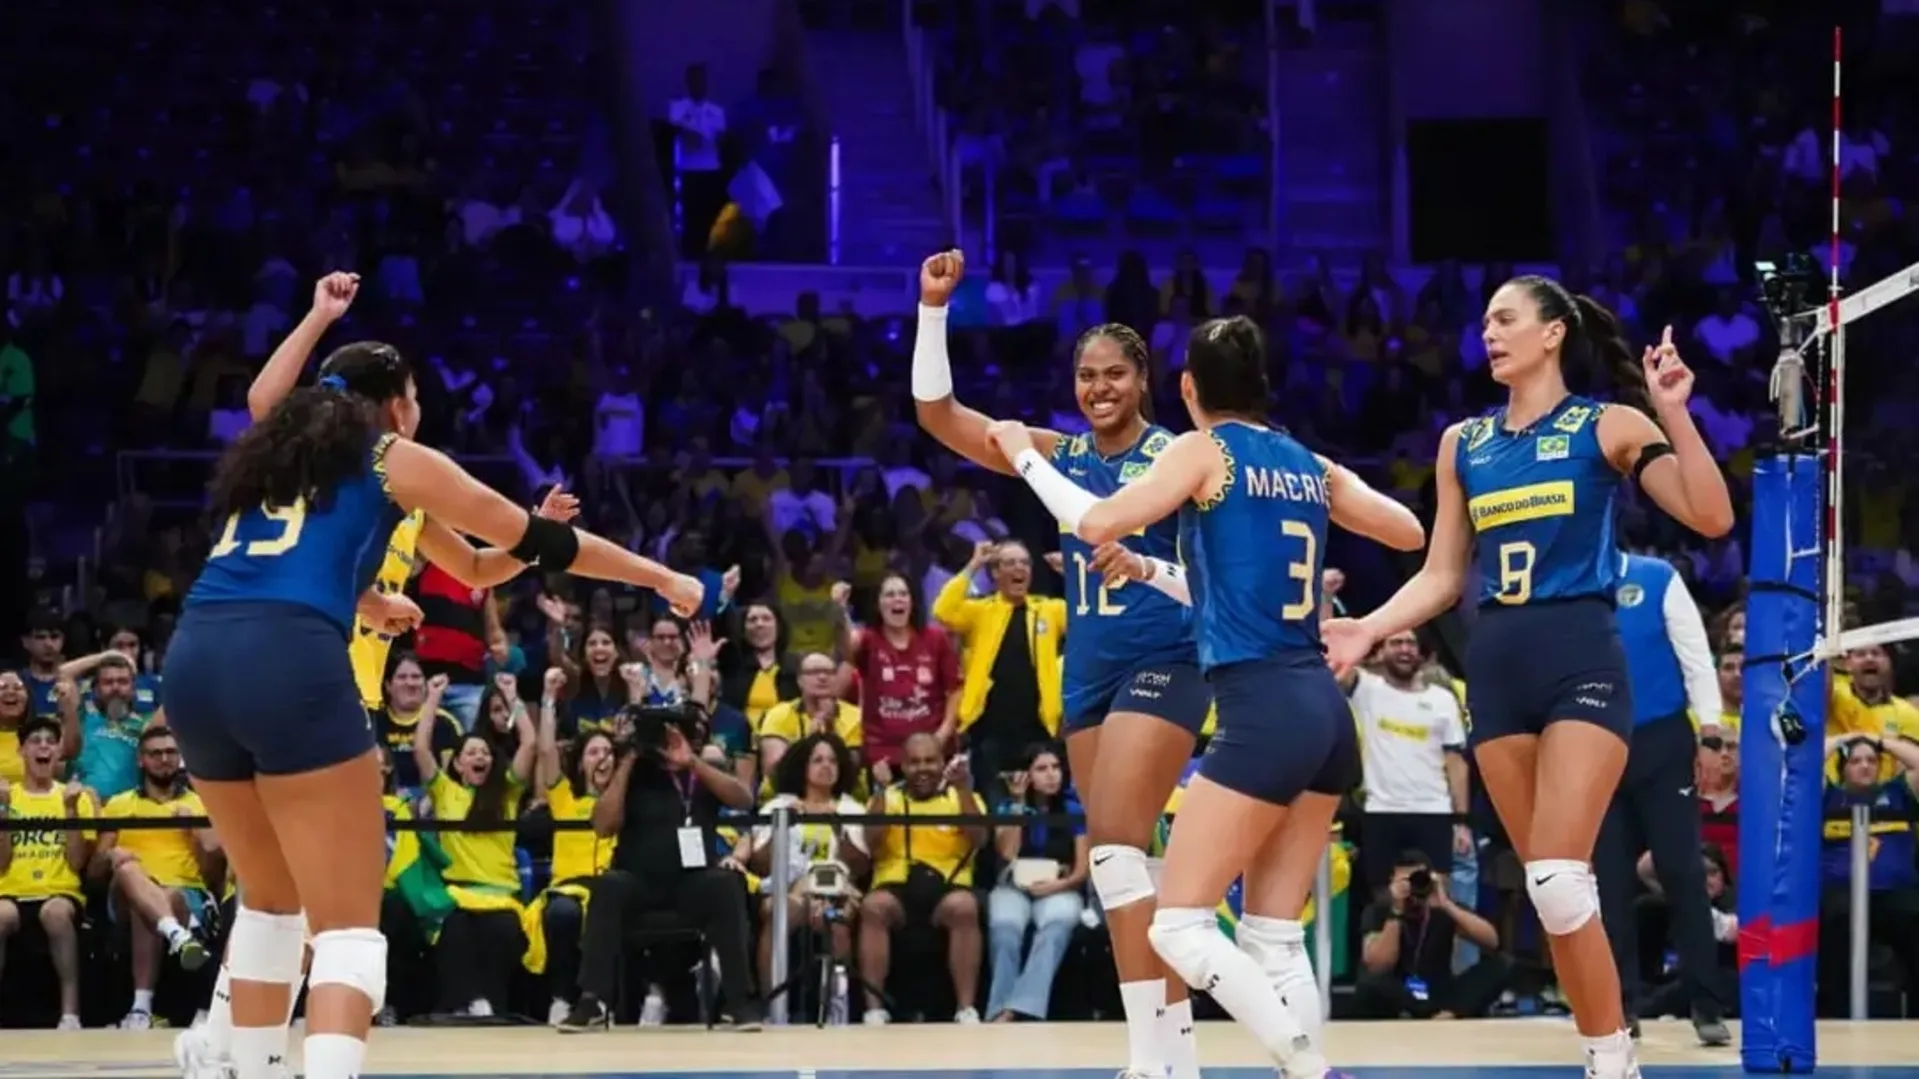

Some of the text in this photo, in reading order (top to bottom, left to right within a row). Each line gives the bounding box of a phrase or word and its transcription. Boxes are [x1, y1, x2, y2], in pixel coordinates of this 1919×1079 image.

[1479, 501, 1515, 518] BANCO
[1529, 493, 1567, 508] BRASIL
[1280, 519, 1317, 620] 3
[1494, 540, 1536, 605] 8
